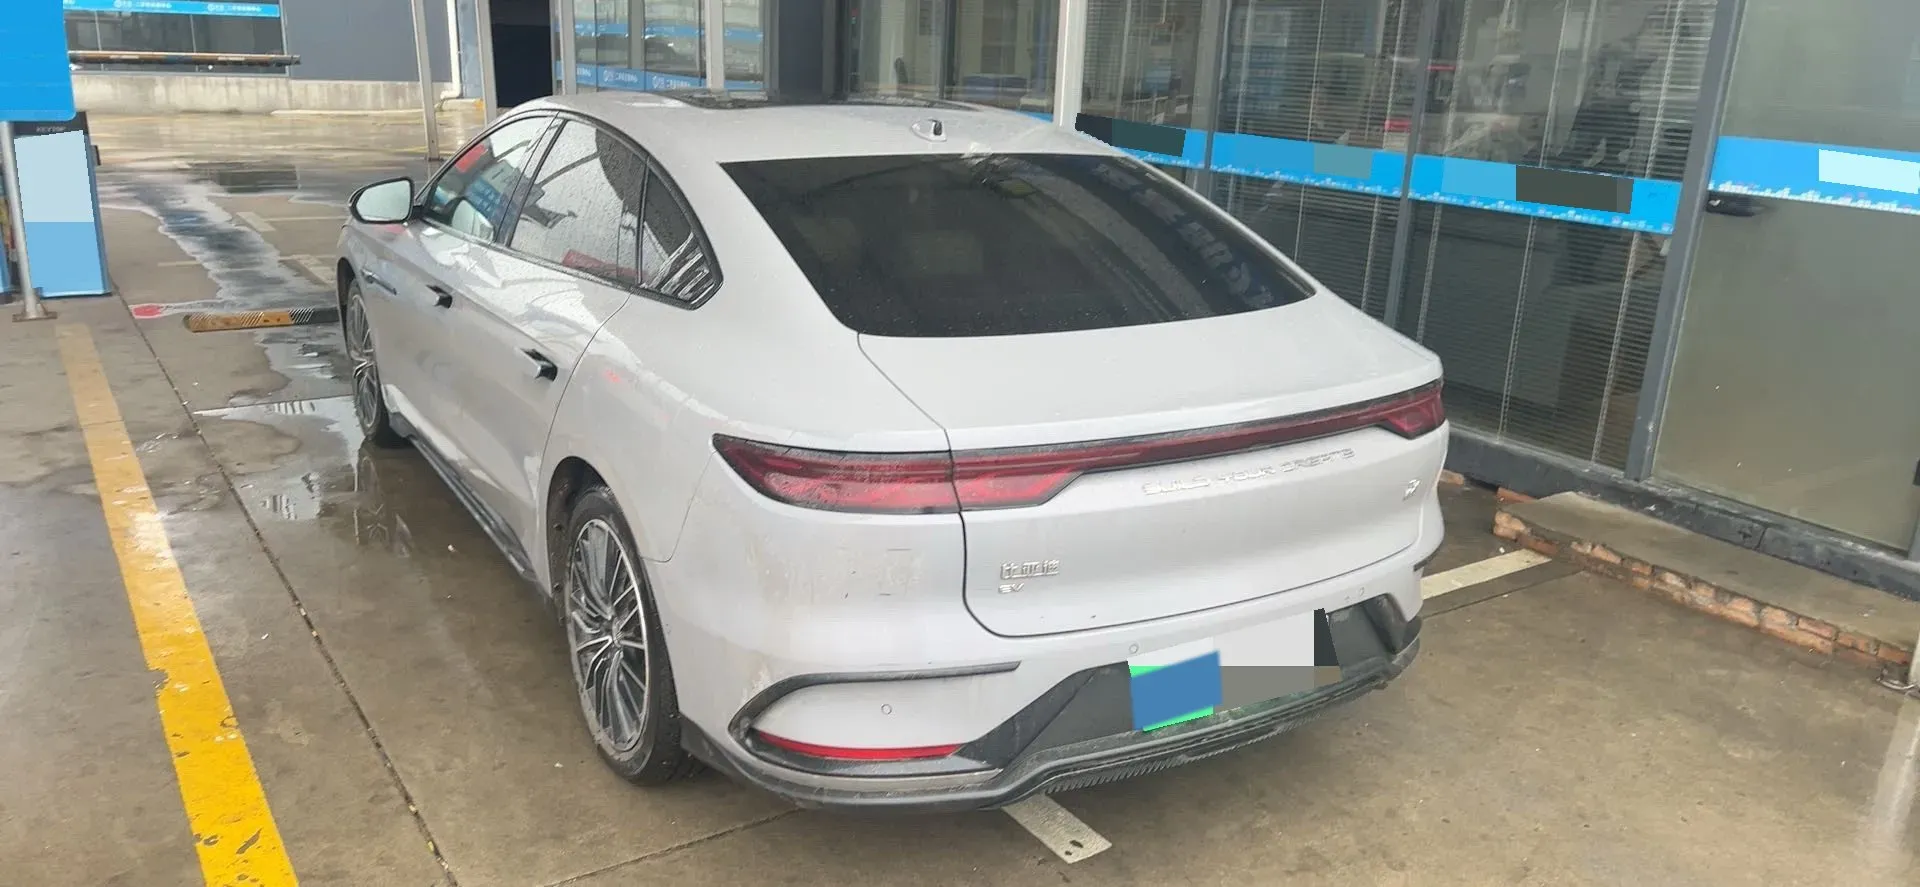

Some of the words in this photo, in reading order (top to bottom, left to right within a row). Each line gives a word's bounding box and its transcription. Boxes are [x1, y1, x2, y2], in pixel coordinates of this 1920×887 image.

[1142, 476, 1211, 495] BUILD
[1217, 466, 1276, 484] YOUR
[1000, 559, 1060, 580] 比亚迪
[998, 582, 1025, 594] EV
